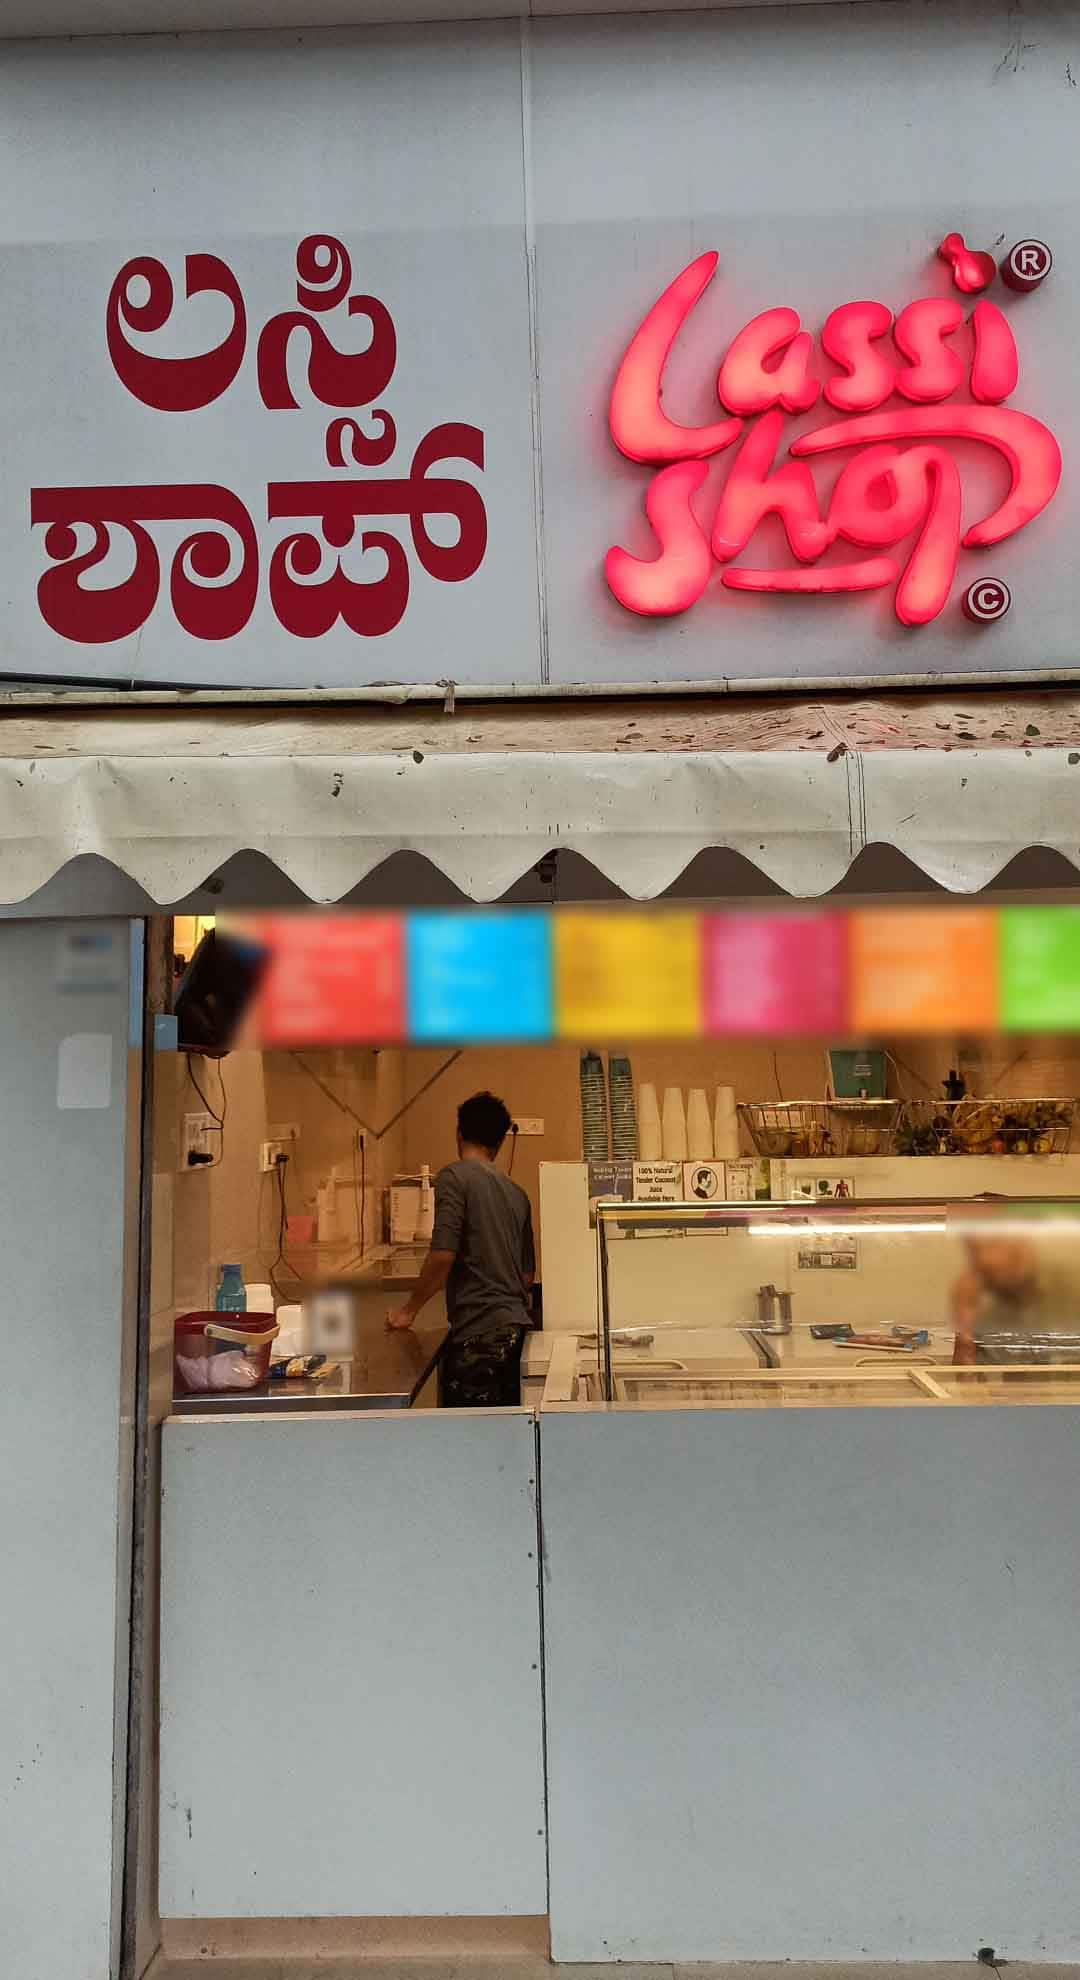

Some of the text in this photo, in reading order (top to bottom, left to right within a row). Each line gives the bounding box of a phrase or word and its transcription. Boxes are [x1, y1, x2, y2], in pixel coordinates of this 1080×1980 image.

[105, 233, 398, 468] ಲಸ್ಸಿ
[608, 231, 1020, 466] Lassi
[29, 421, 489, 645] ಶಾಪ್
